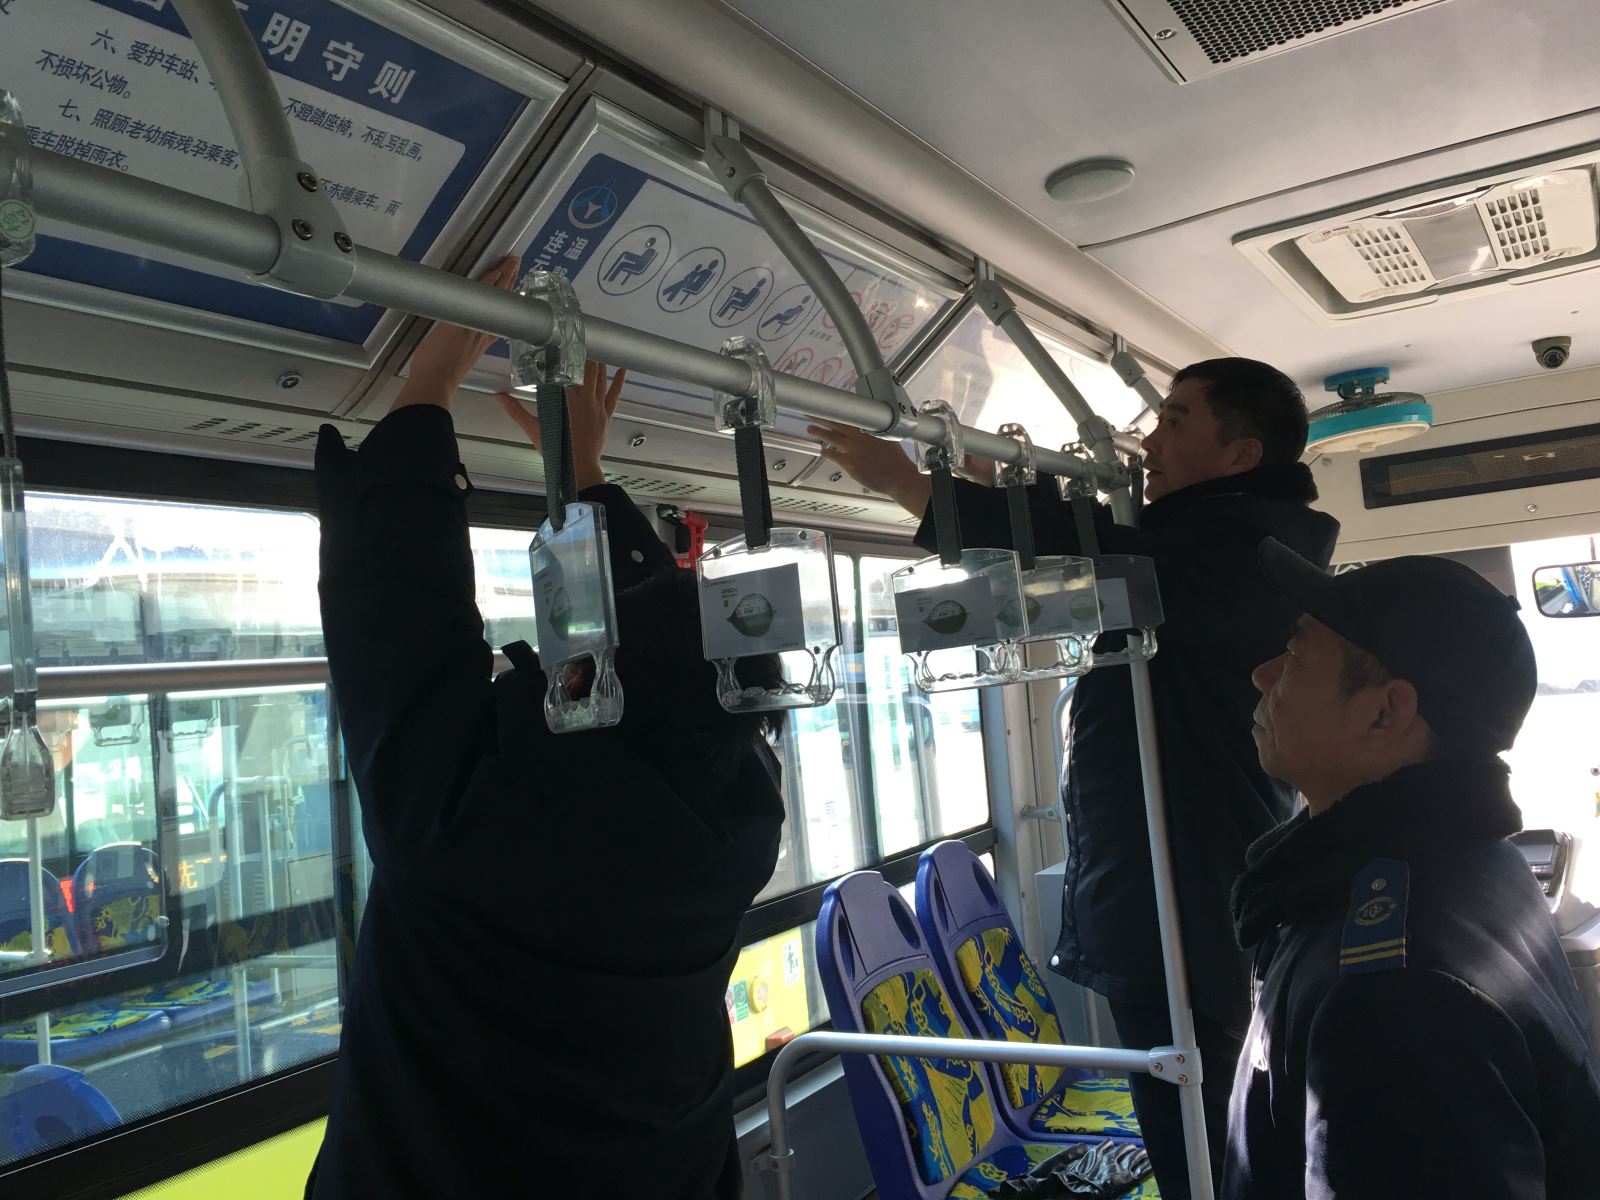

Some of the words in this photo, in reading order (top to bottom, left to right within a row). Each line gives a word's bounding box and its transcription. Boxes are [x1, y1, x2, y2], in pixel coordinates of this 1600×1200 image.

[35, 49, 131, 99] 不损坏公物。
[91, 29, 217, 91] 六、爱护车站、
[261, 12, 416, 104] 明守则
[25, 125, 129, 172] 乘车脱掉雨衣。
[58, 98, 240, 169] 七、照顾老幼病残孕乘客，
